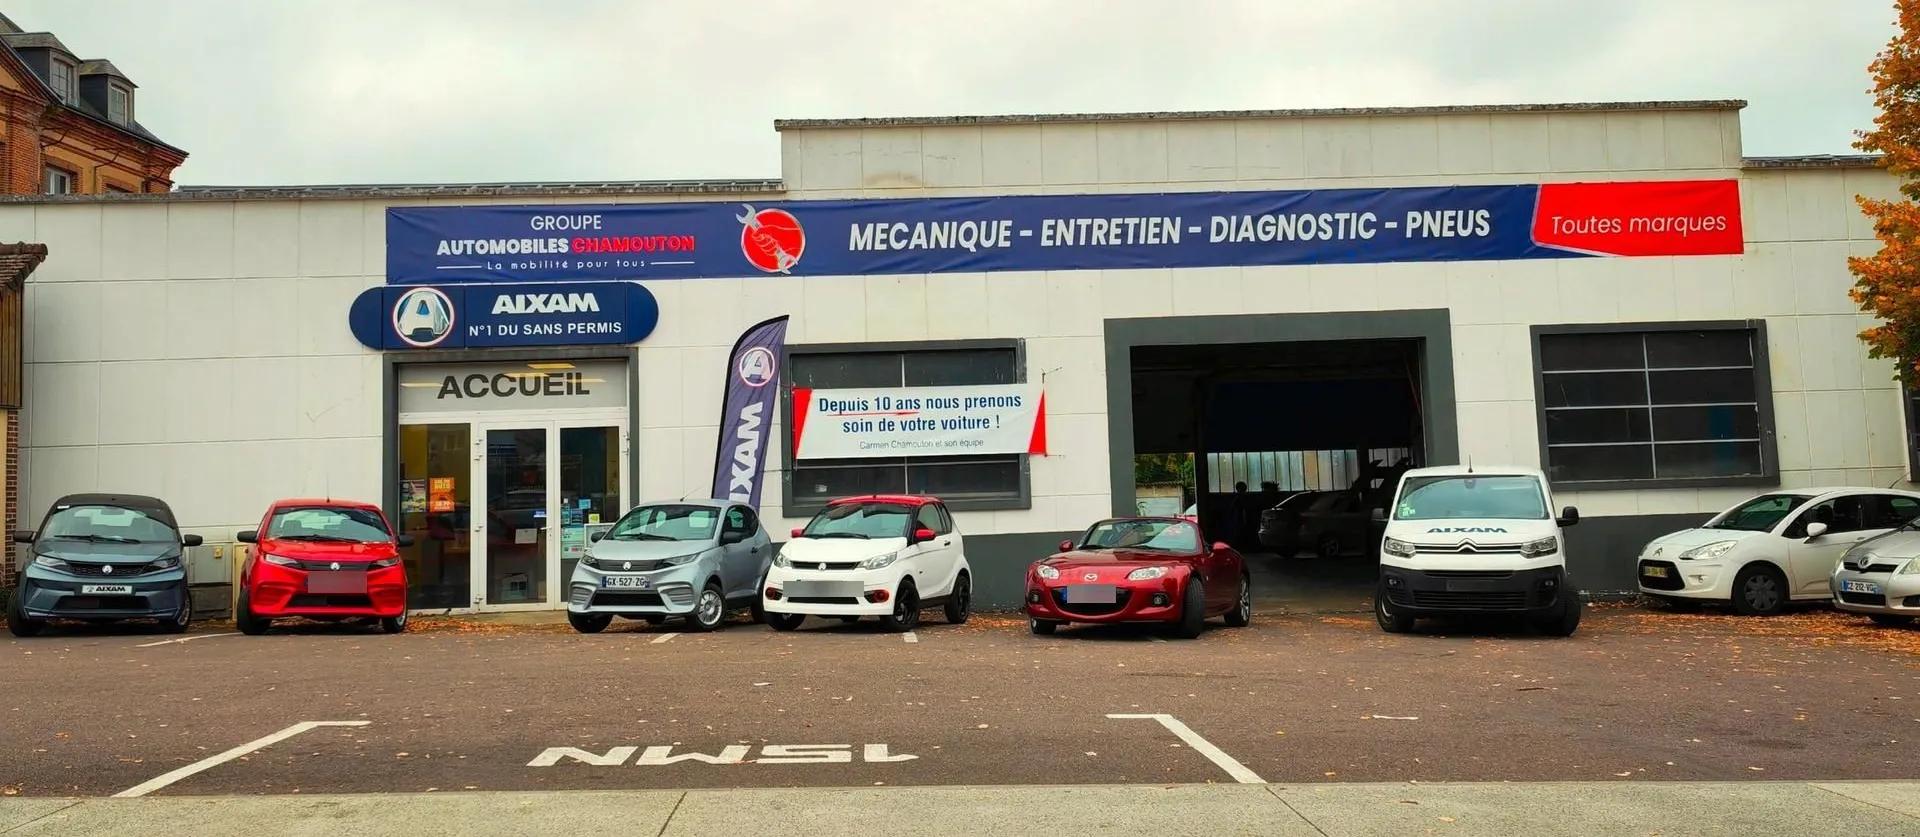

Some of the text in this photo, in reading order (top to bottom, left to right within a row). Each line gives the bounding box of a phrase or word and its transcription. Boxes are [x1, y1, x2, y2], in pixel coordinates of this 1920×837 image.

[530, 215, 602, 231] GROUPE
[849, 219, 1013, 252] MECANIQUE
[1040, 216, 1182, 247] ENTRETIEN
[1209, 211, 1377, 243] DIAGNOSTIC
[1405, 209, 1490, 238] PNEUS
[1551, 214, 1727, 237] Toutes marques
[436, 235, 696, 256] AUTOMOBILES CHAMOUTON
[487, 259, 646, 270] La mobilité pour tous
[491, 293, 600, 314] AIXAM
[469, 322, 622, 337] N°1 DU SANS PERMIS
[437, 372, 590, 399] ACCUEIL
[819, 394, 1021, 415] Depuis 10 ans nous prenons
[843, 417, 873, 433] soin
[878, 416, 895, 432] de
[900, 416, 936, 431] votre
[940, 415, 990, 430] voiture
[728, 401, 764, 504] IXAM
